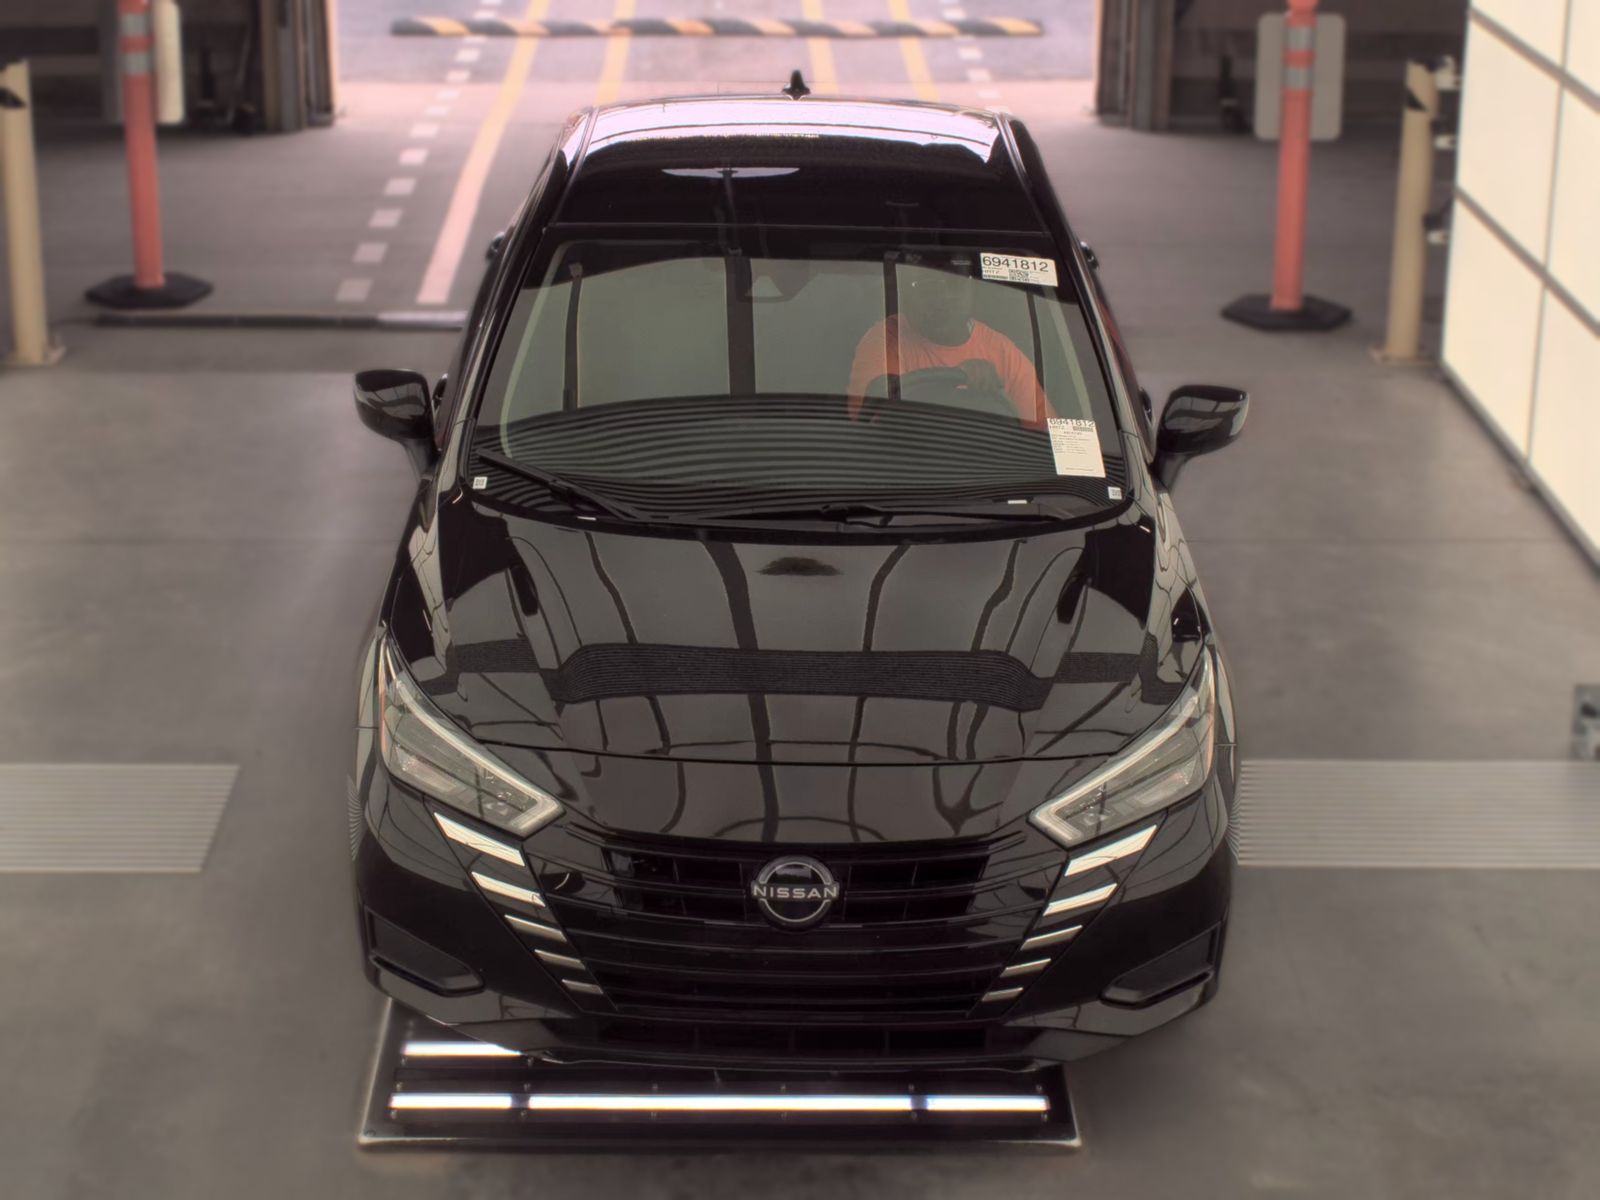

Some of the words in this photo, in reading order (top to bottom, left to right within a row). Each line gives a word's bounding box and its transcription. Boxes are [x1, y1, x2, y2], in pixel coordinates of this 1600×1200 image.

[983, 256, 1048, 272] 6941812
[1049, 418, 1095, 428] 6941812
[753, 885, 837, 898] NISSAN
